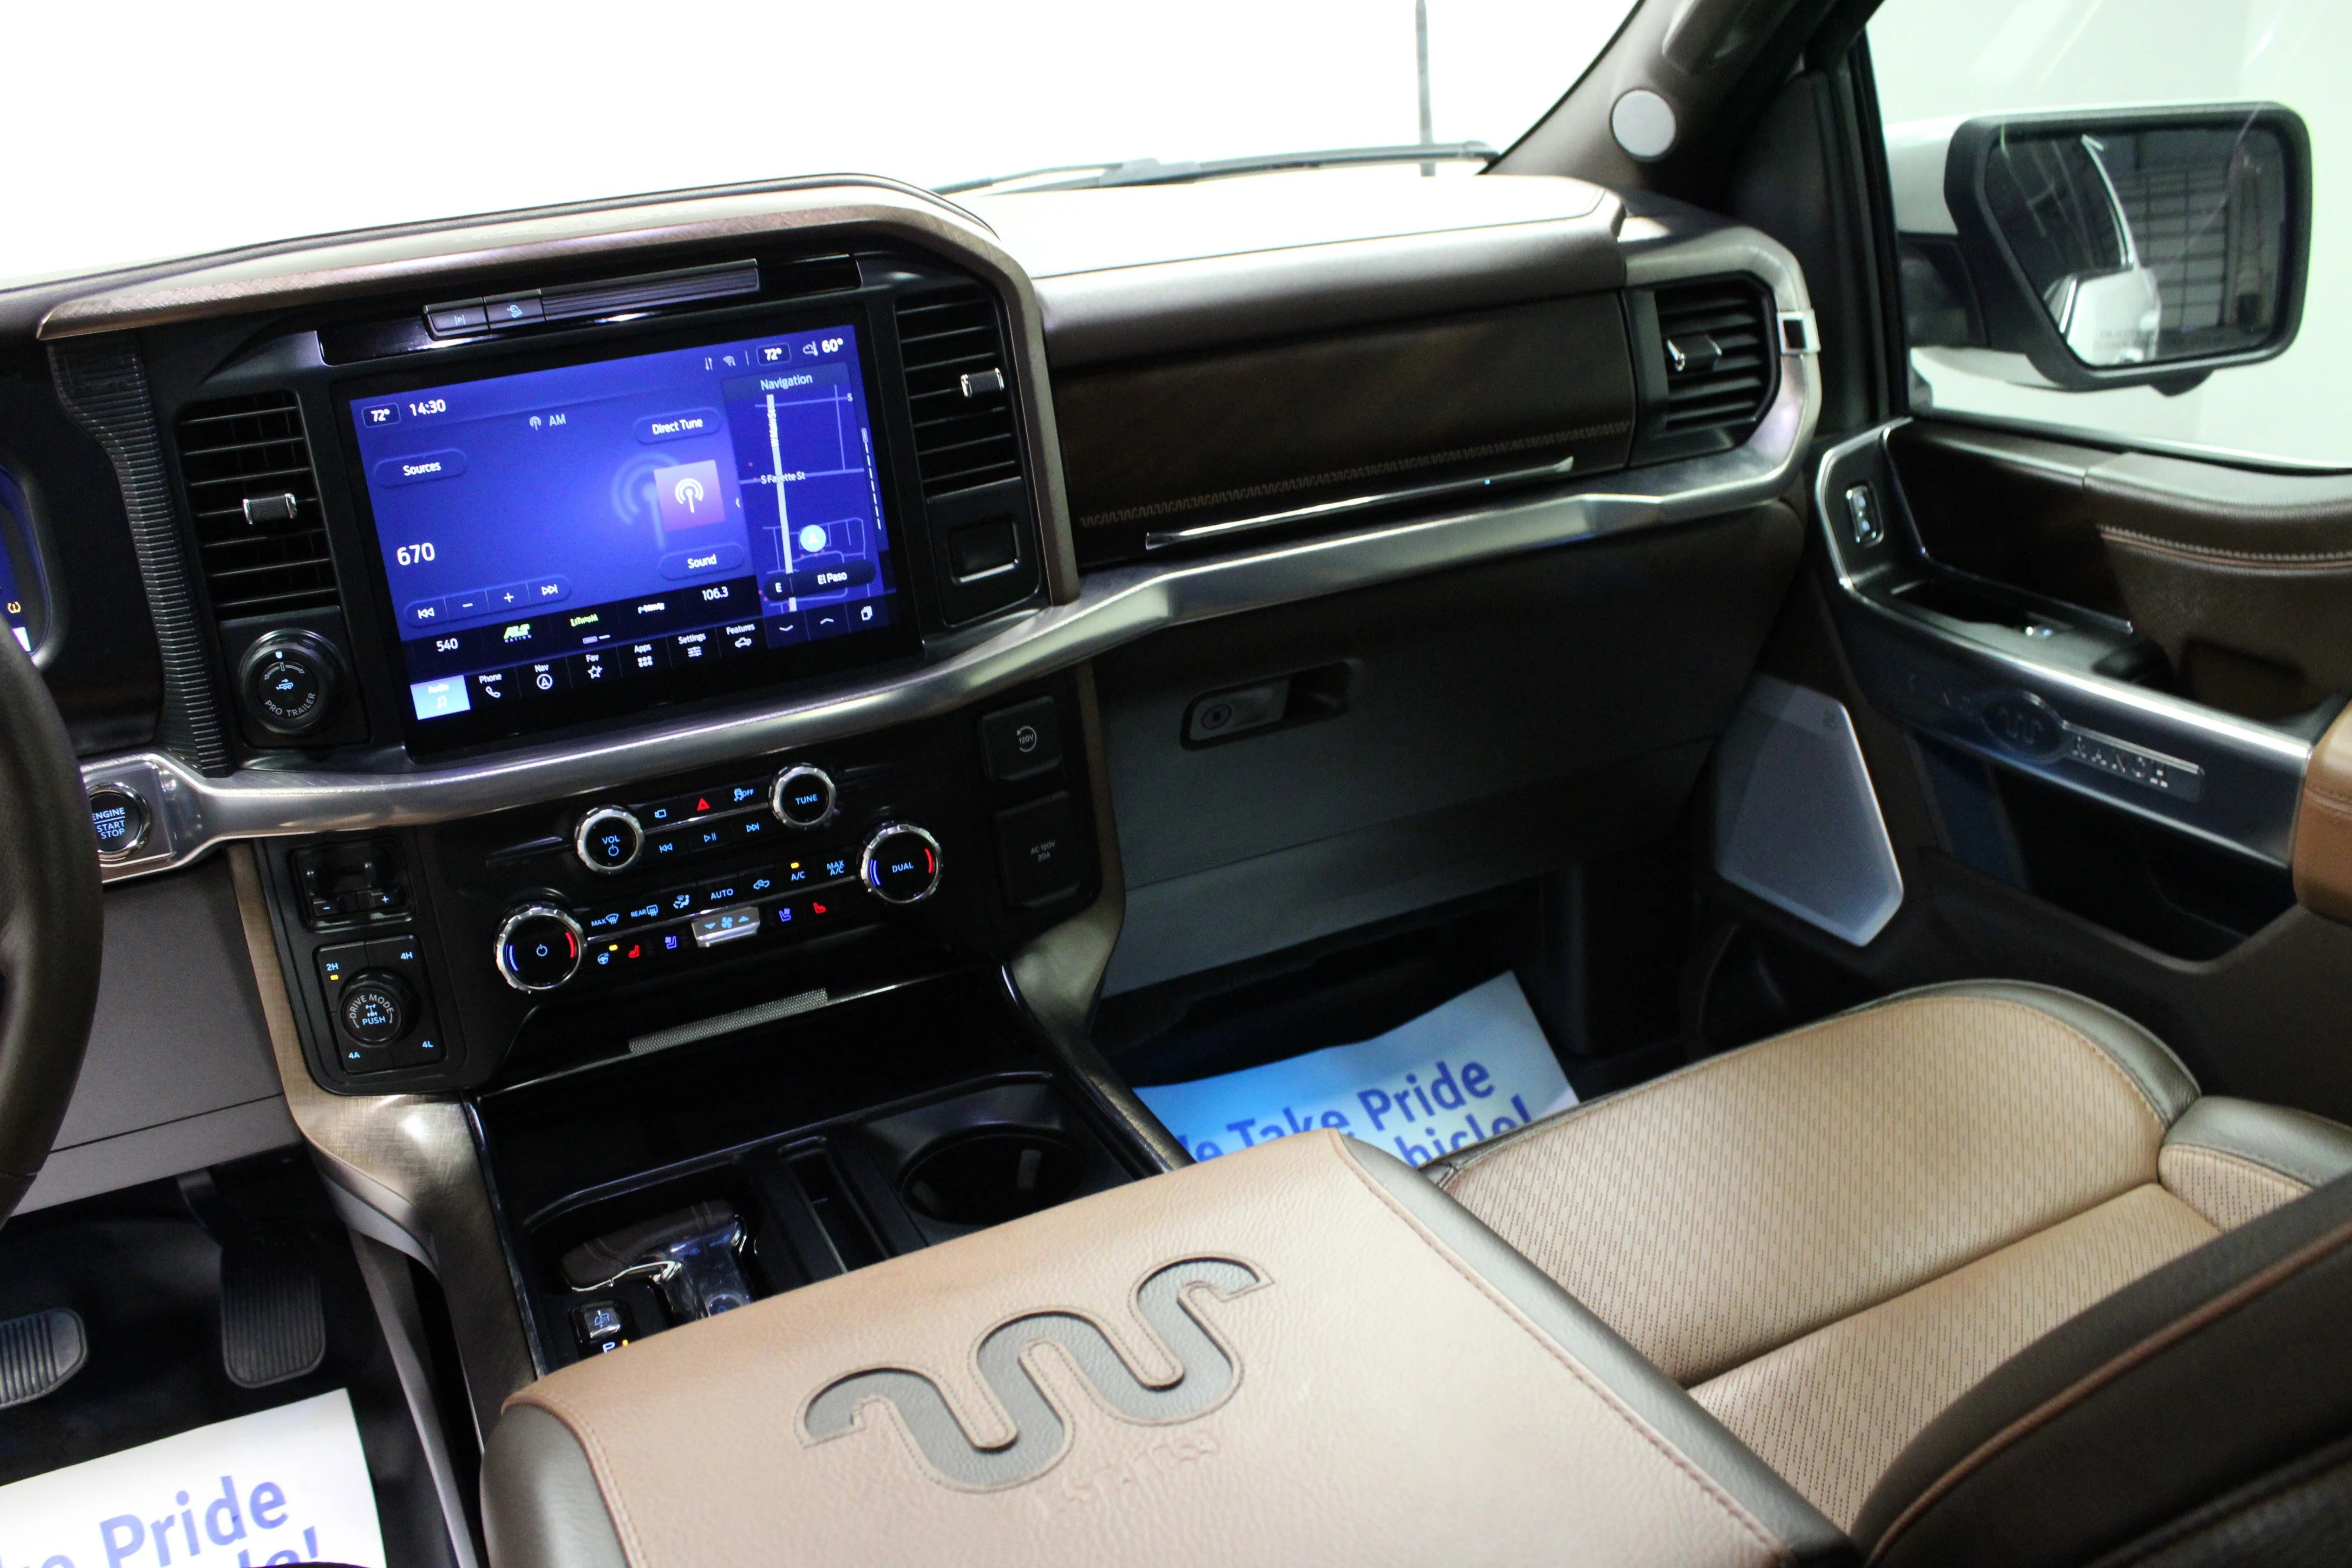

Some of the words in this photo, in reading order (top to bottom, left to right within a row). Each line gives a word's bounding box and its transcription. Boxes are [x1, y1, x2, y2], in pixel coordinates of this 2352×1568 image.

[760, 374, 813, 390] Navigation
[409, 399, 446, 417] 14:30
[549, 413, 567, 427] AM
[652, 422, 678, 435] Direct
[680, 418, 703, 430] Tune
[403, 461, 442, 476] Sources
[796, 471, 806, 481] St
[397, 542, 436, 566] 670
[687, 554, 717, 569] Sound
[817, 574, 826, 585] El
[827, 571, 847, 583] Paso
[702, 586, 729, 601] 106.3
[726, 623, 755, 635] Features
[678, 632, 707, 645] Settings
[436, 638, 458, 652] 540
[634, 643, 652, 653] Apps
[586, 654, 599, 662] Fav
[534, 664, 549, 673] Nav
[479, 672, 502, 684] Phone
[264, 700, 282, 716] PRO
[286, 692, 316, 717] TRAILER
[742, 788, 754, 796] OFF
[795, 793, 818, 805] TUNE
[96, 820, 125, 832] START
[100, 828, 125, 839] STOP
[602, 834, 620, 845] VOL
[827, 860, 845, 871] MAX
[829, 865, 845, 877] A/C
[891, 861, 914, 873] DUAL
[790, 870, 806, 881] A/C
[710, 888, 734, 900] AUTO
[631, 909, 647, 918] REAR
[591, 917, 607, 927] MAX
[400, 951, 413, 961] 4H
[326, 962, 339, 972] 2H
[349, 995, 368, 1020] DRIVE
[368, 993, 394, 1014] MODE
[362, 1015, 387, 1026] PUSH
[422, 1040, 434, 1049] 4L
[348, 1051, 361, 1060] 4A
[1357, 1060, 1496, 1132] Pride
[602, 1341, 616, 1354] P
[99, 1475, 289, 1568] Pride
